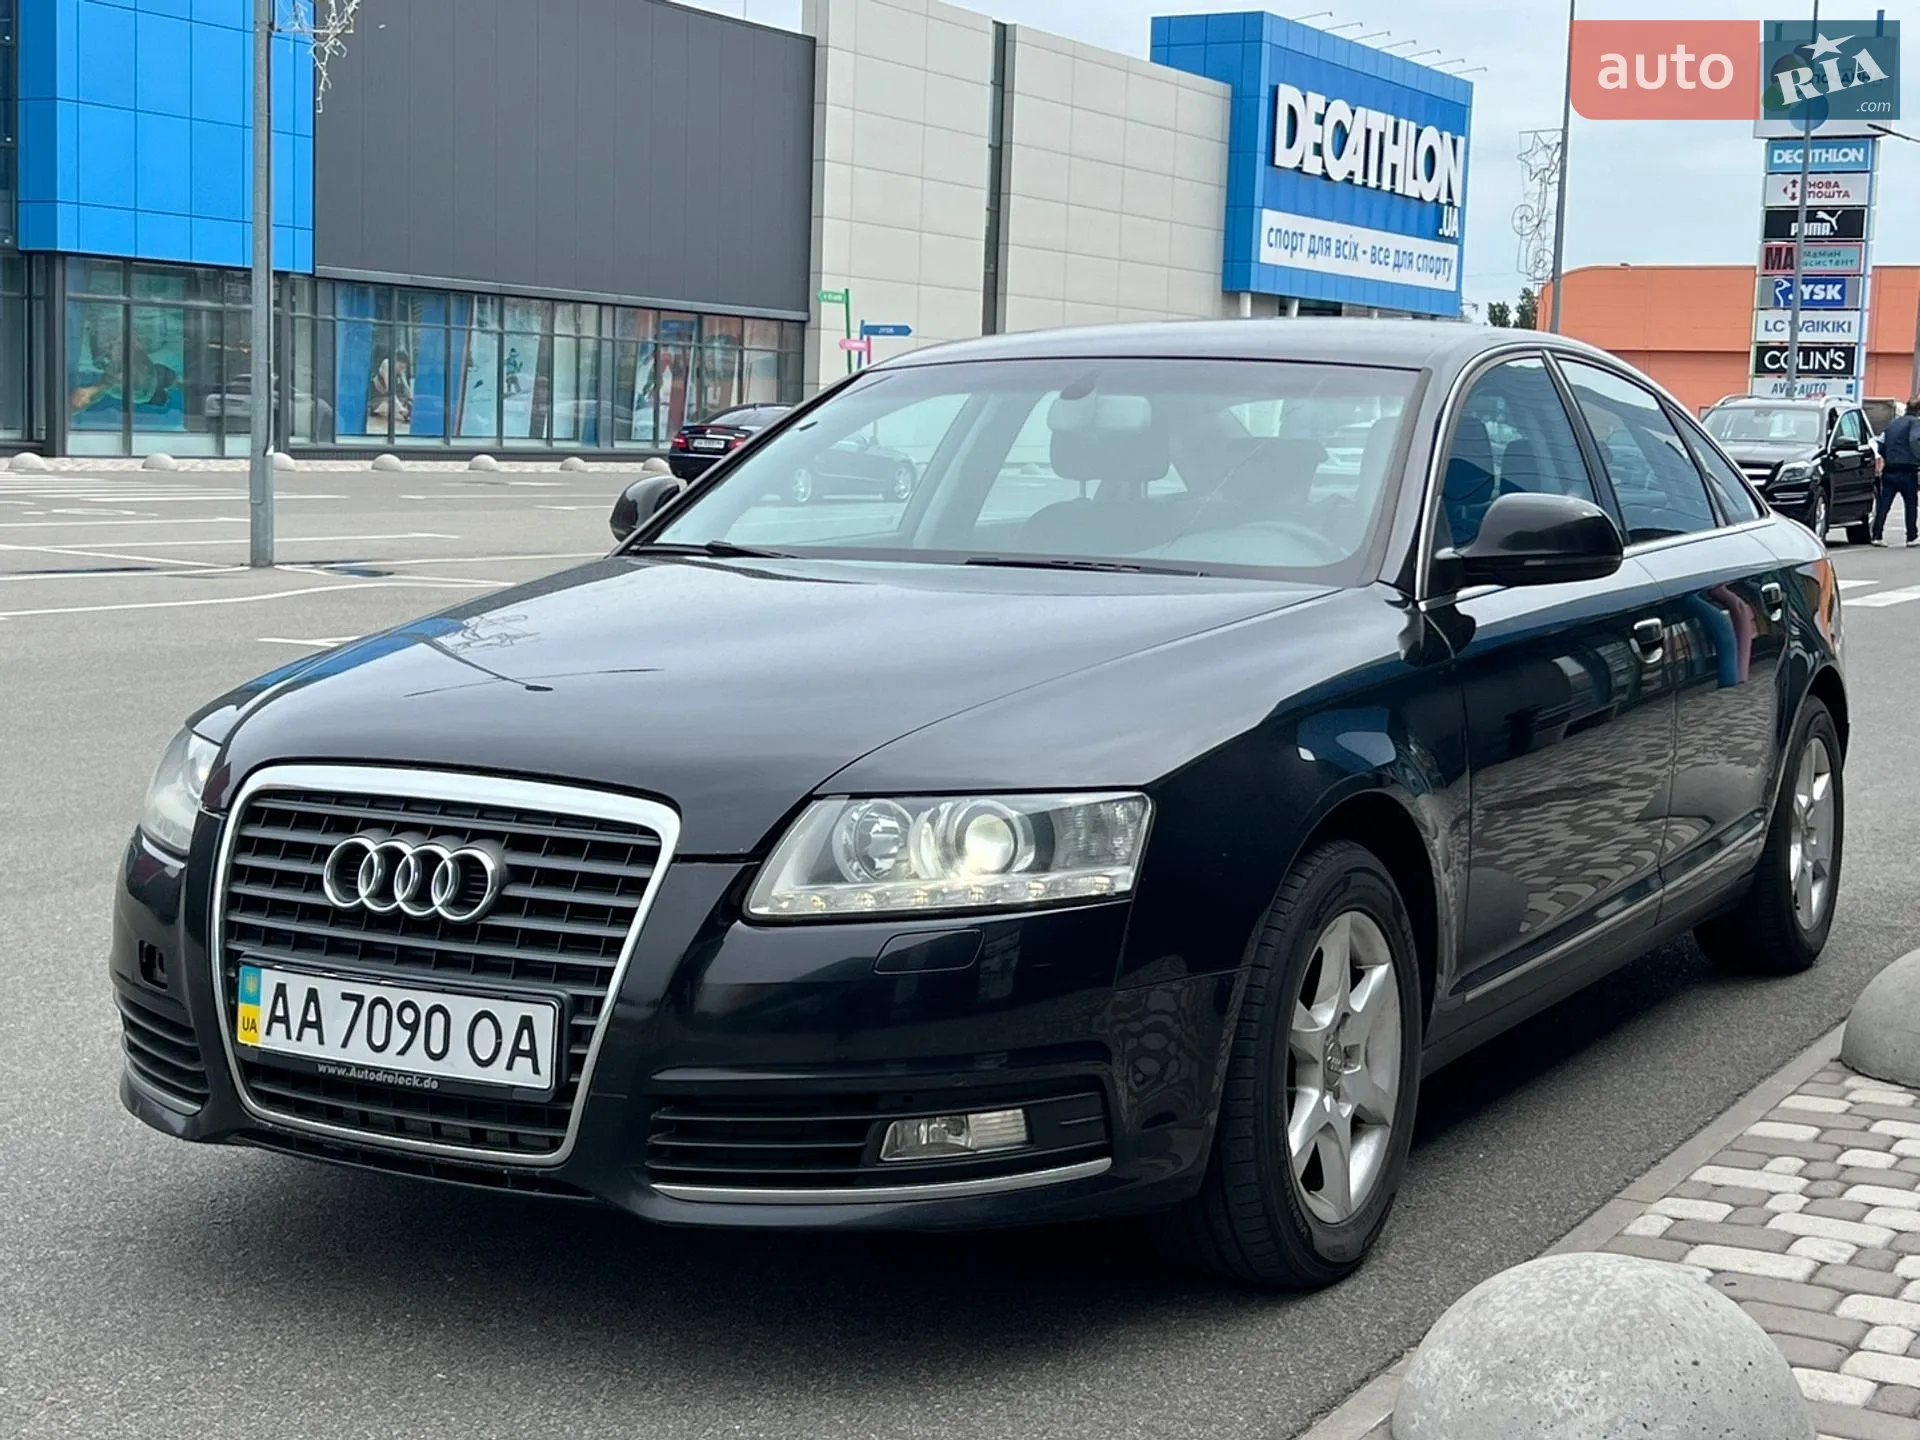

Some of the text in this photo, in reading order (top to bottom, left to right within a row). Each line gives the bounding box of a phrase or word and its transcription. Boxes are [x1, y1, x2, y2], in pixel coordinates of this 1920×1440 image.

[1274, 83, 1465, 207] DECATHLON
[1773, 147, 1864, 164] DECTHLON
[1807, 180, 1840, 190] НОВА
[1807, 190, 1850, 199] ПОШТА
[1438, 205, 1459, 239] .UA
[1267, 226, 1305, 259] спорт
[1307, 234, 1331, 260] для
[1335, 234, 1358, 261] всіх
[1371, 245, 1390, 266] все
[1393, 249, 1413, 272] для
[1416, 254, 1454, 281] спорту
[1788, 284, 1843, 301] YSK
[1764, 319, 1785, 332] LC
[242, 1016, 258, 1033] UA
[265, 982, 541, 1075] AA 7090 OA
